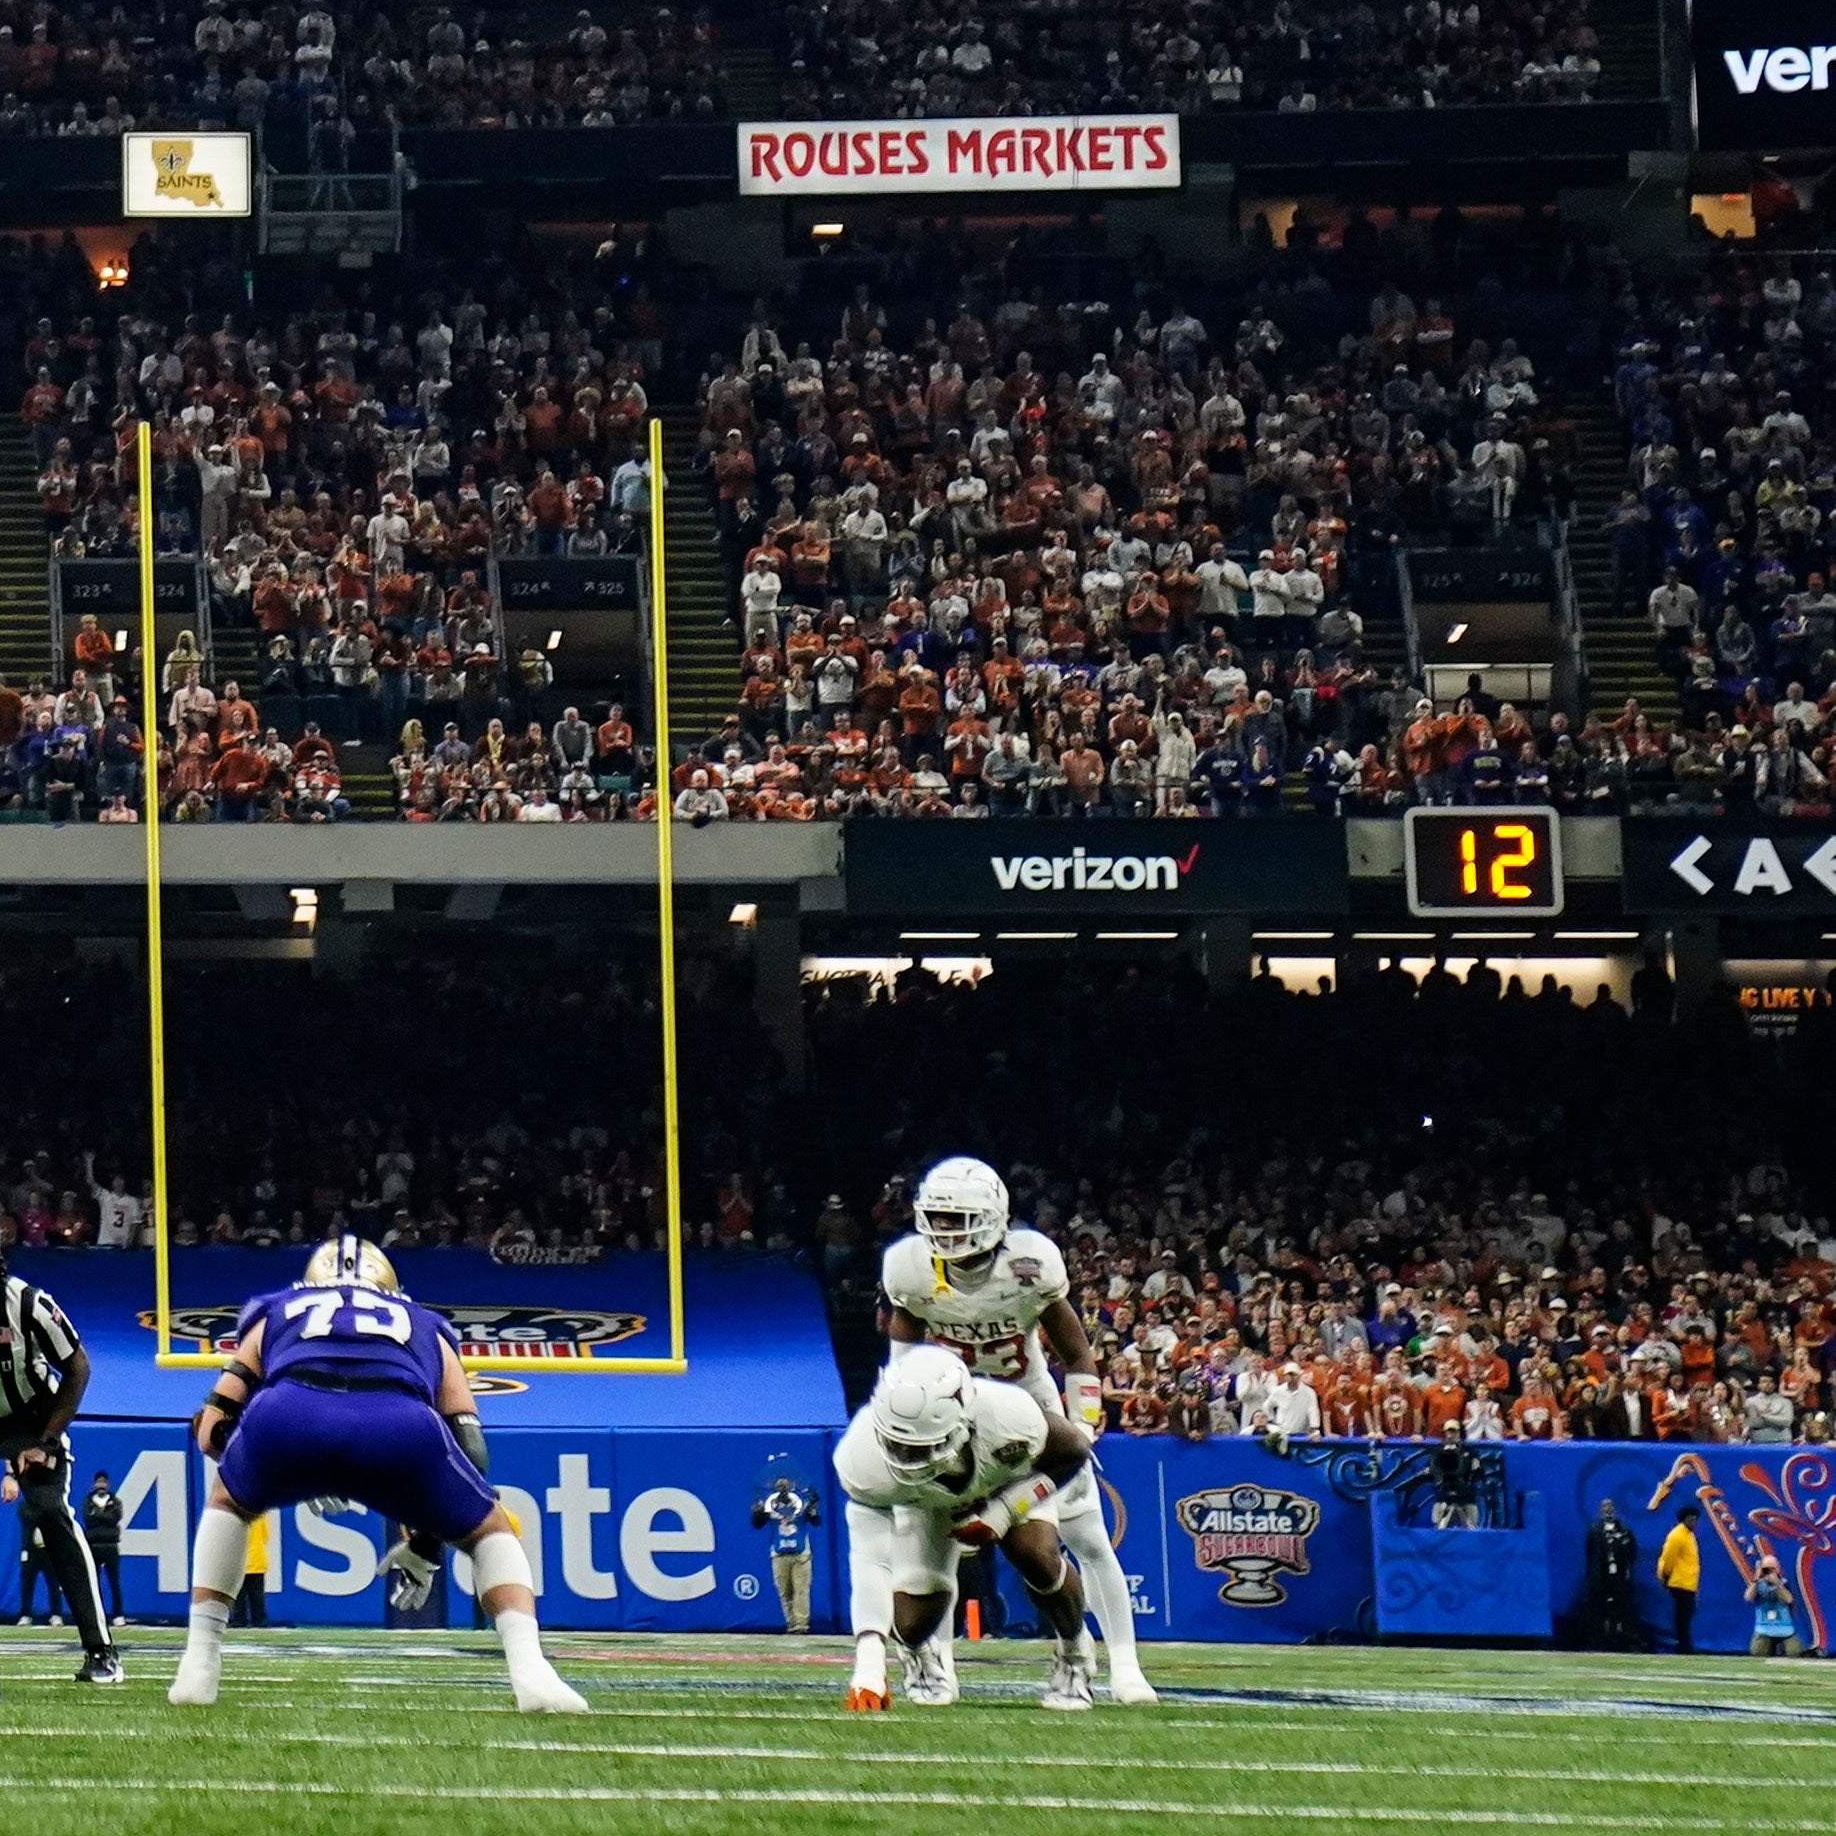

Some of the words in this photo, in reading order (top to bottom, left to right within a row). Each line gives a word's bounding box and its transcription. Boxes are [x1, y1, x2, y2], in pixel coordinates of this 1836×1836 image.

[749, 129, 930, 183] ROUSES
[946, 125, 1169, 177] MARKETS
[157, 173, 213, 191] SAINTS
[990, 845, 1180, 892] verizon
[1460, 823, 1536, 899] 12
[1199, 1510, 1294, 1534] Allstate
